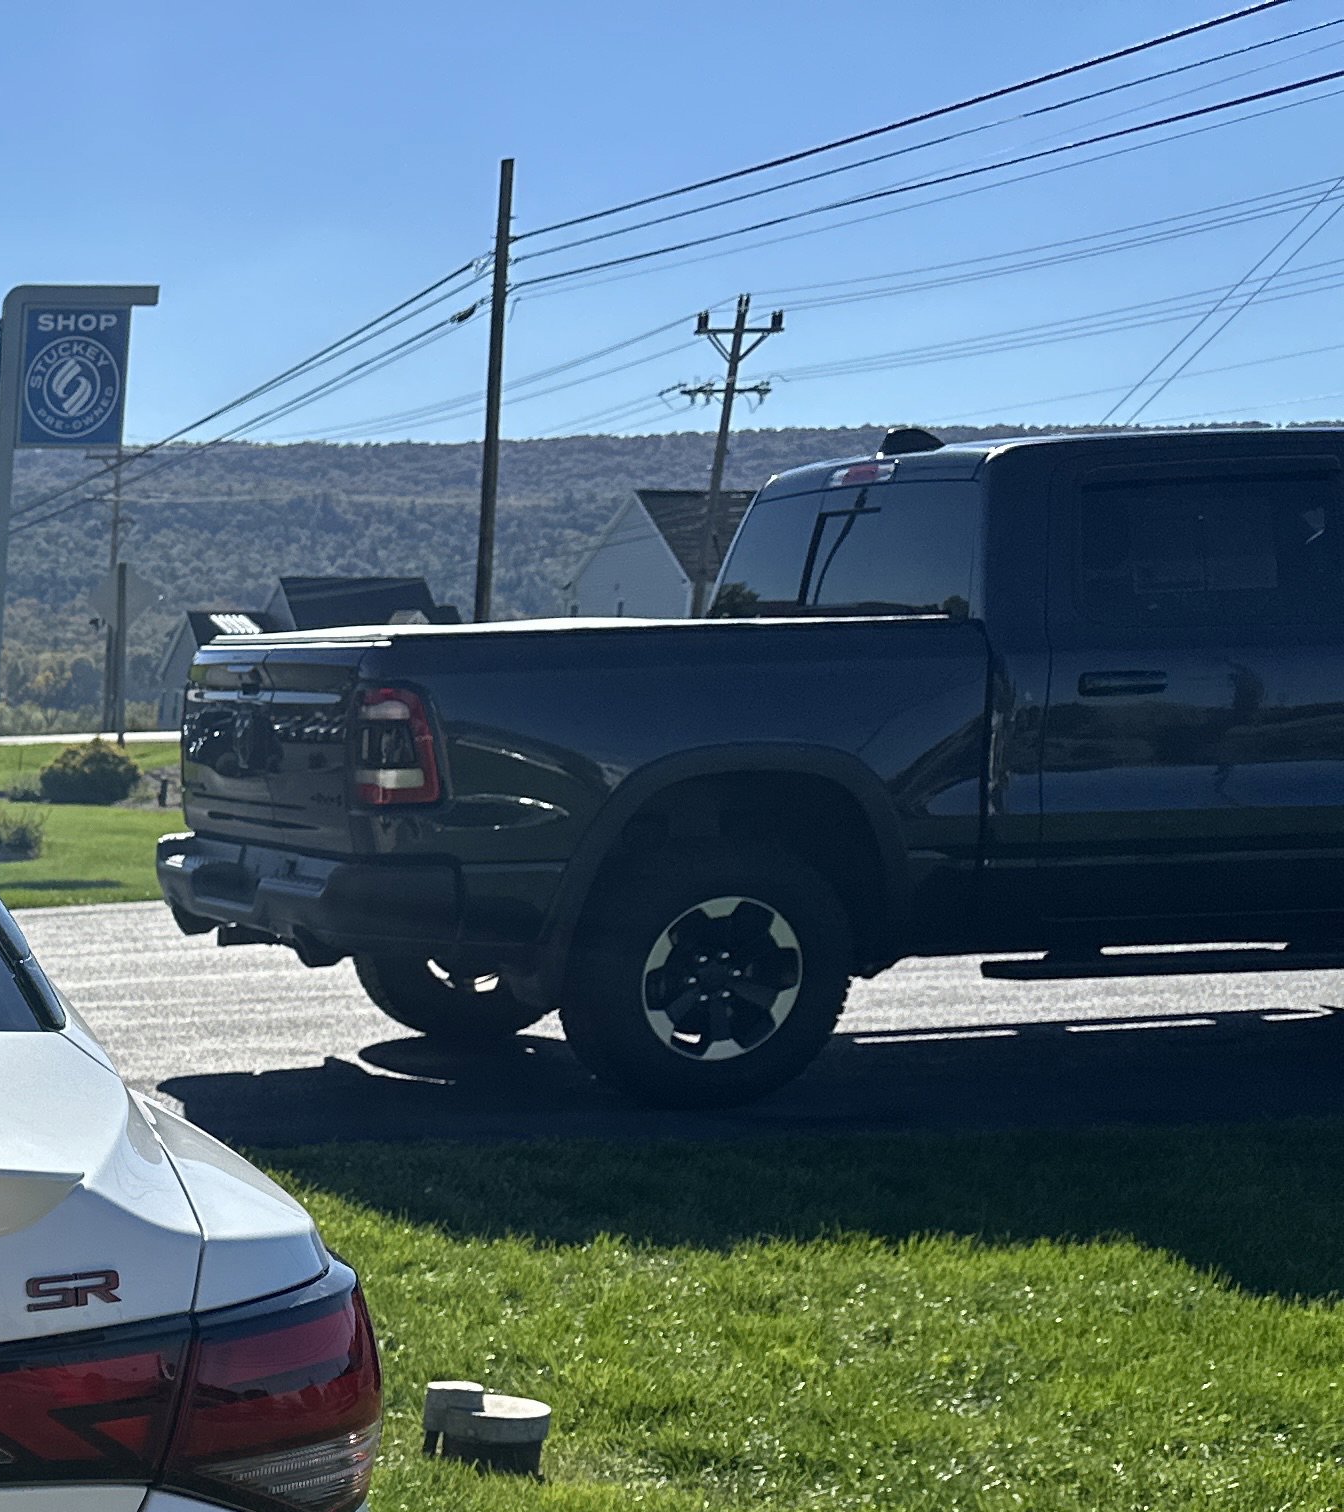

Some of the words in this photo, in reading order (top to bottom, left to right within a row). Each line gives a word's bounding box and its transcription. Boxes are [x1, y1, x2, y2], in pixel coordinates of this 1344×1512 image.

[37, 313, 118, 331] SHOP
[30, 341, 110, 389] STUCKEY
[26, 1269, 122, 1312] SR
